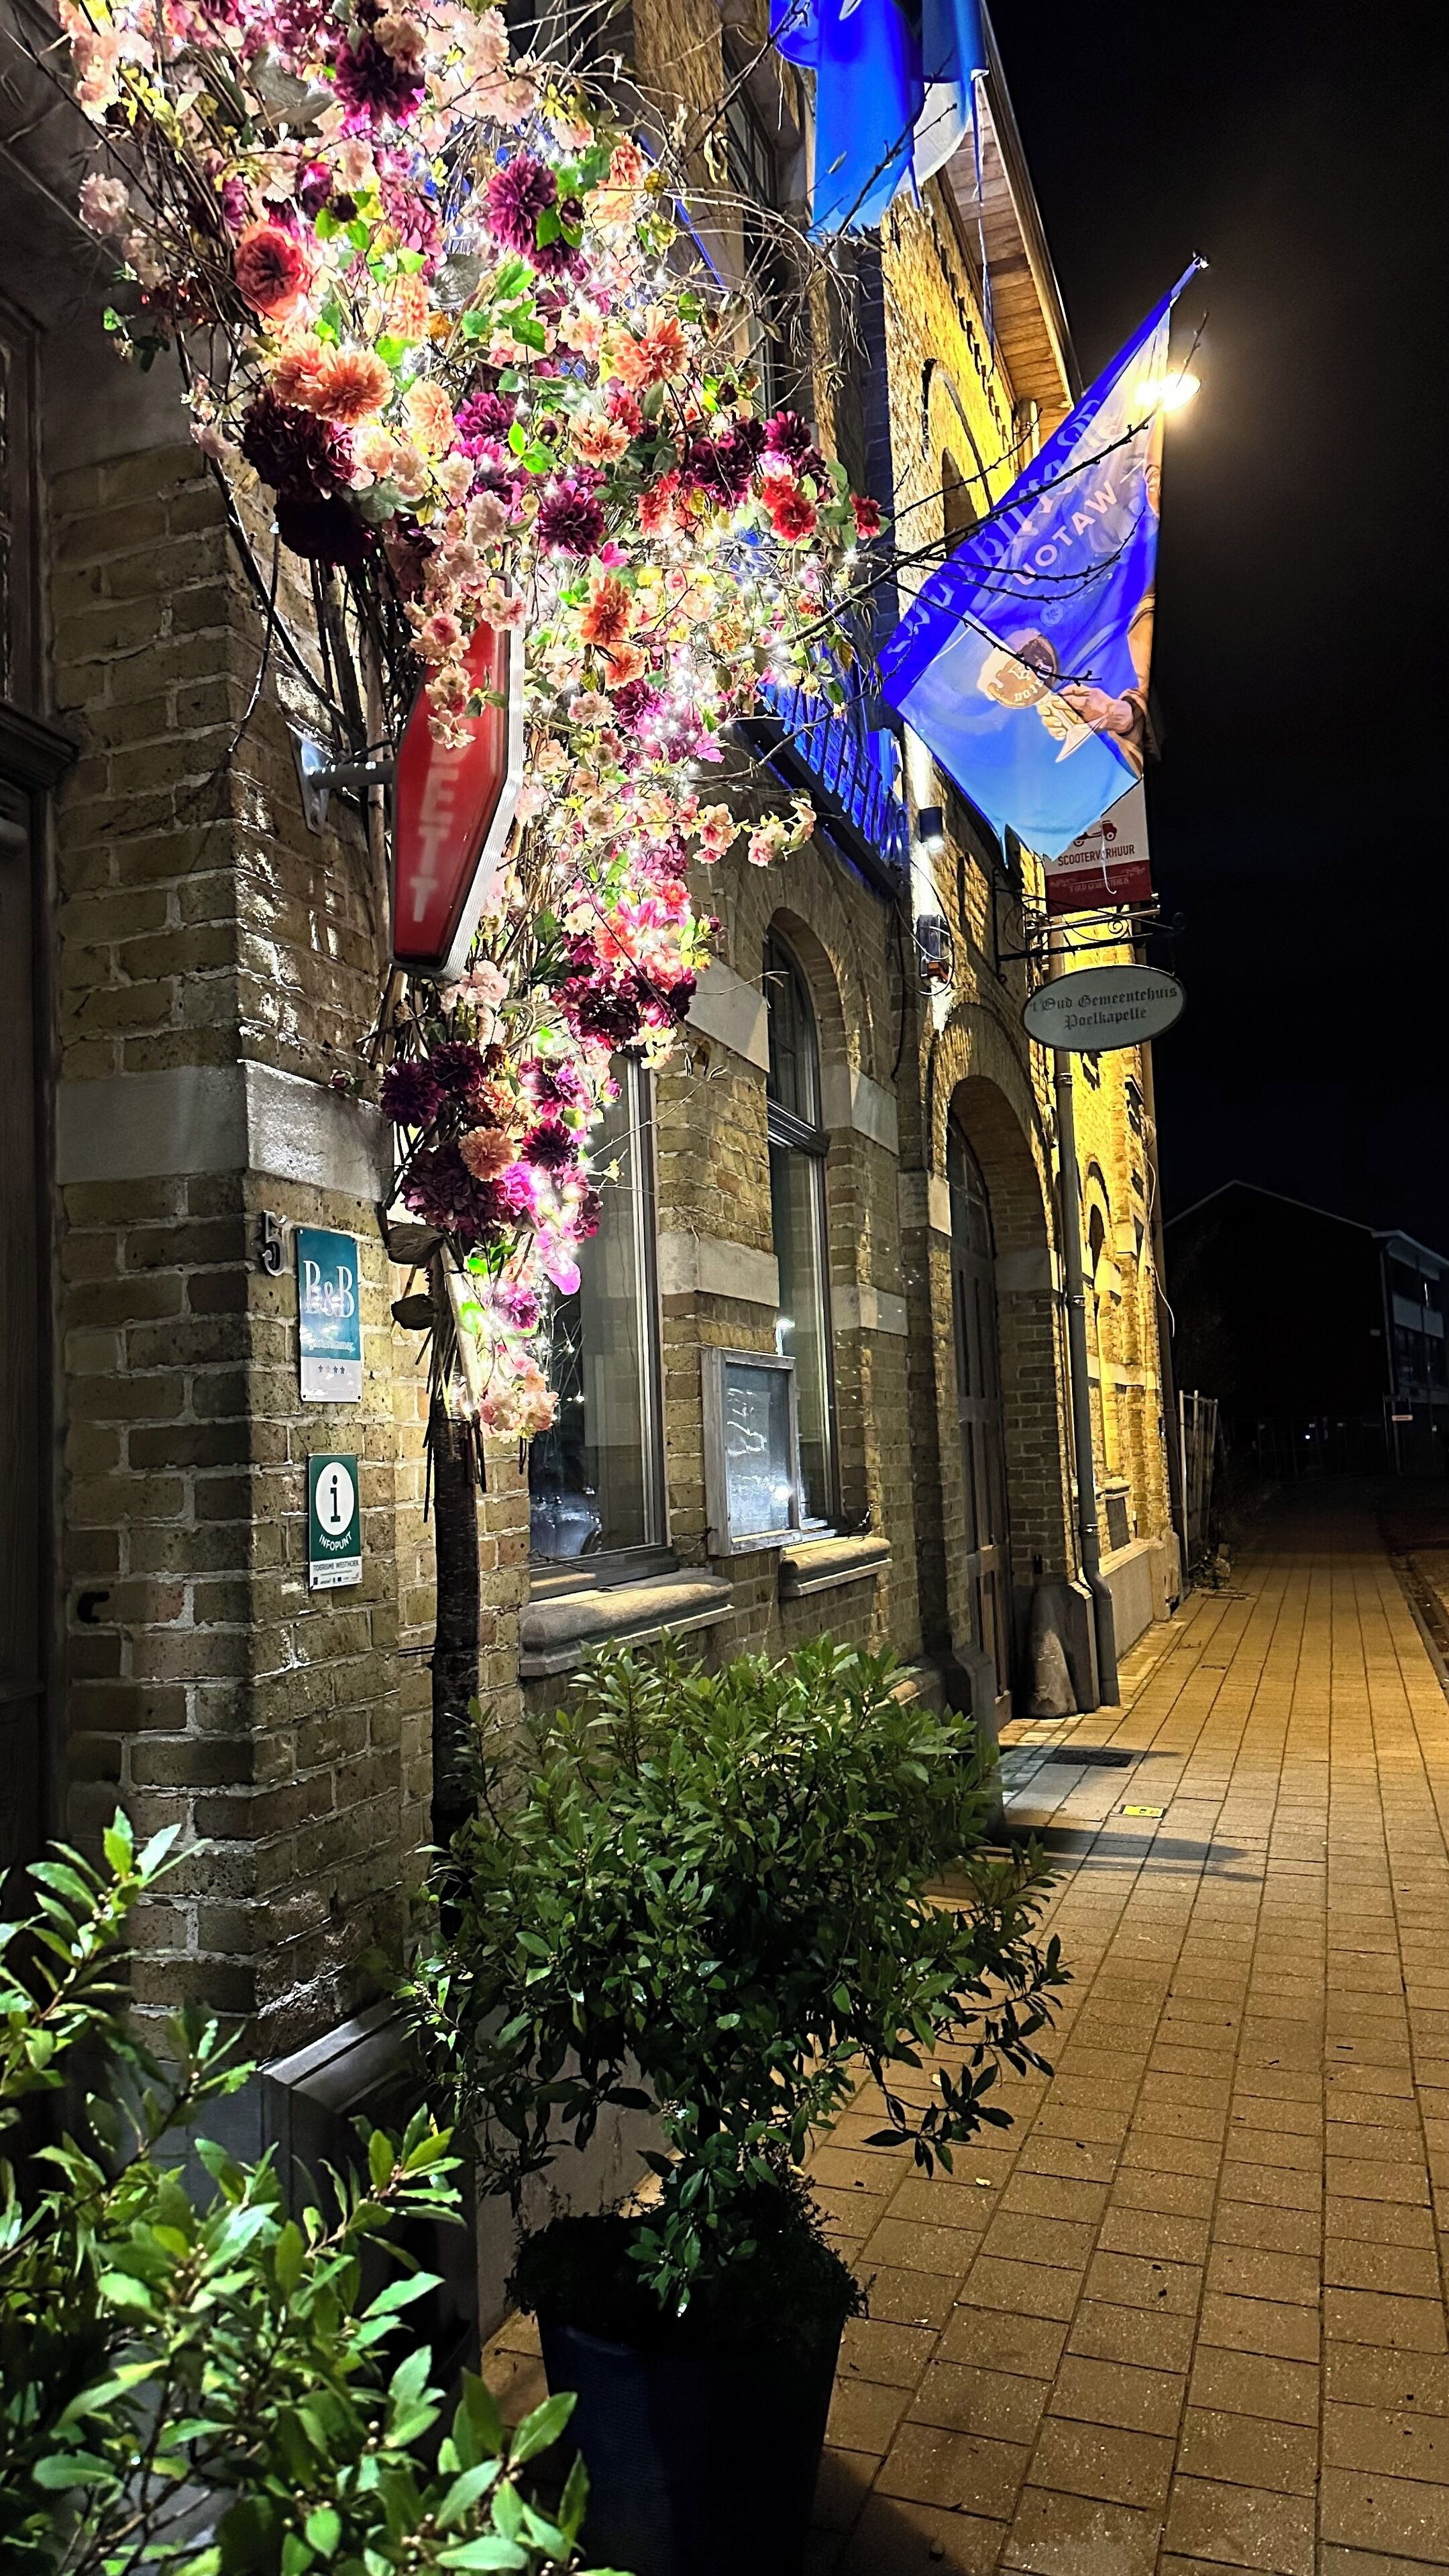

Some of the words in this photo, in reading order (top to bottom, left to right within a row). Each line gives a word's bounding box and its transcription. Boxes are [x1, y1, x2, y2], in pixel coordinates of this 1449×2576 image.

[1058, 845, 1135, 866] SCOOTERVRHUUR
[1042, 997, 1073, 1010] Oud
[1078, 987, 1177, 1007] Gemeentehuis
[1063, 1008, 1146, 1030] Poelkapelle
[262, 1210, 287, 1277] 5
[303, 1260, 355, 1318] B&B
[319, 1531, 352, 1551] INFOPUNT
